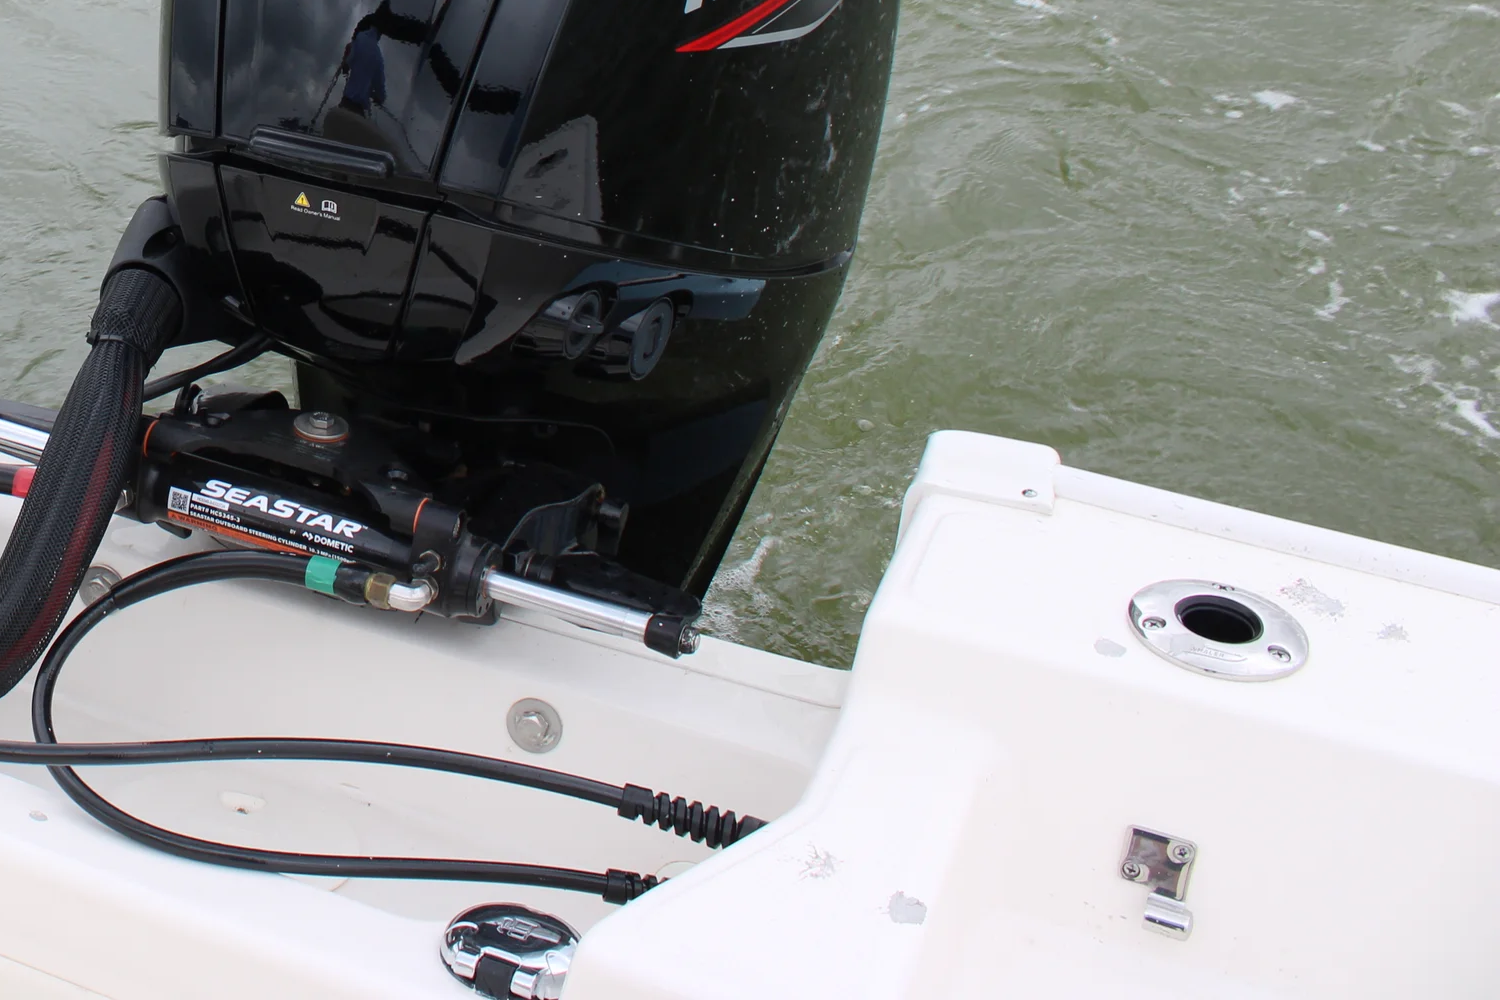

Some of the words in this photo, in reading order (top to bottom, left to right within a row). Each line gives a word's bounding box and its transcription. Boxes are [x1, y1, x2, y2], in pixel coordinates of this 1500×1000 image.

[290, 205, 303, 213] Read
[304, 208, 322, 217] Owner's
[323, 212, 341, 221] Manual
[190, 502, 210, 514] PART#
[200, 479, 362, 539] SEASTAR
[190, 510, 215, 523] SEASTAR
[215, 519, 248, 533] OUTBOARD
[248, 528, 277, 542] STEERING
[277, 537, 308, 551] CYLINDER
[313, 534, 354, 553] DOMETIC
